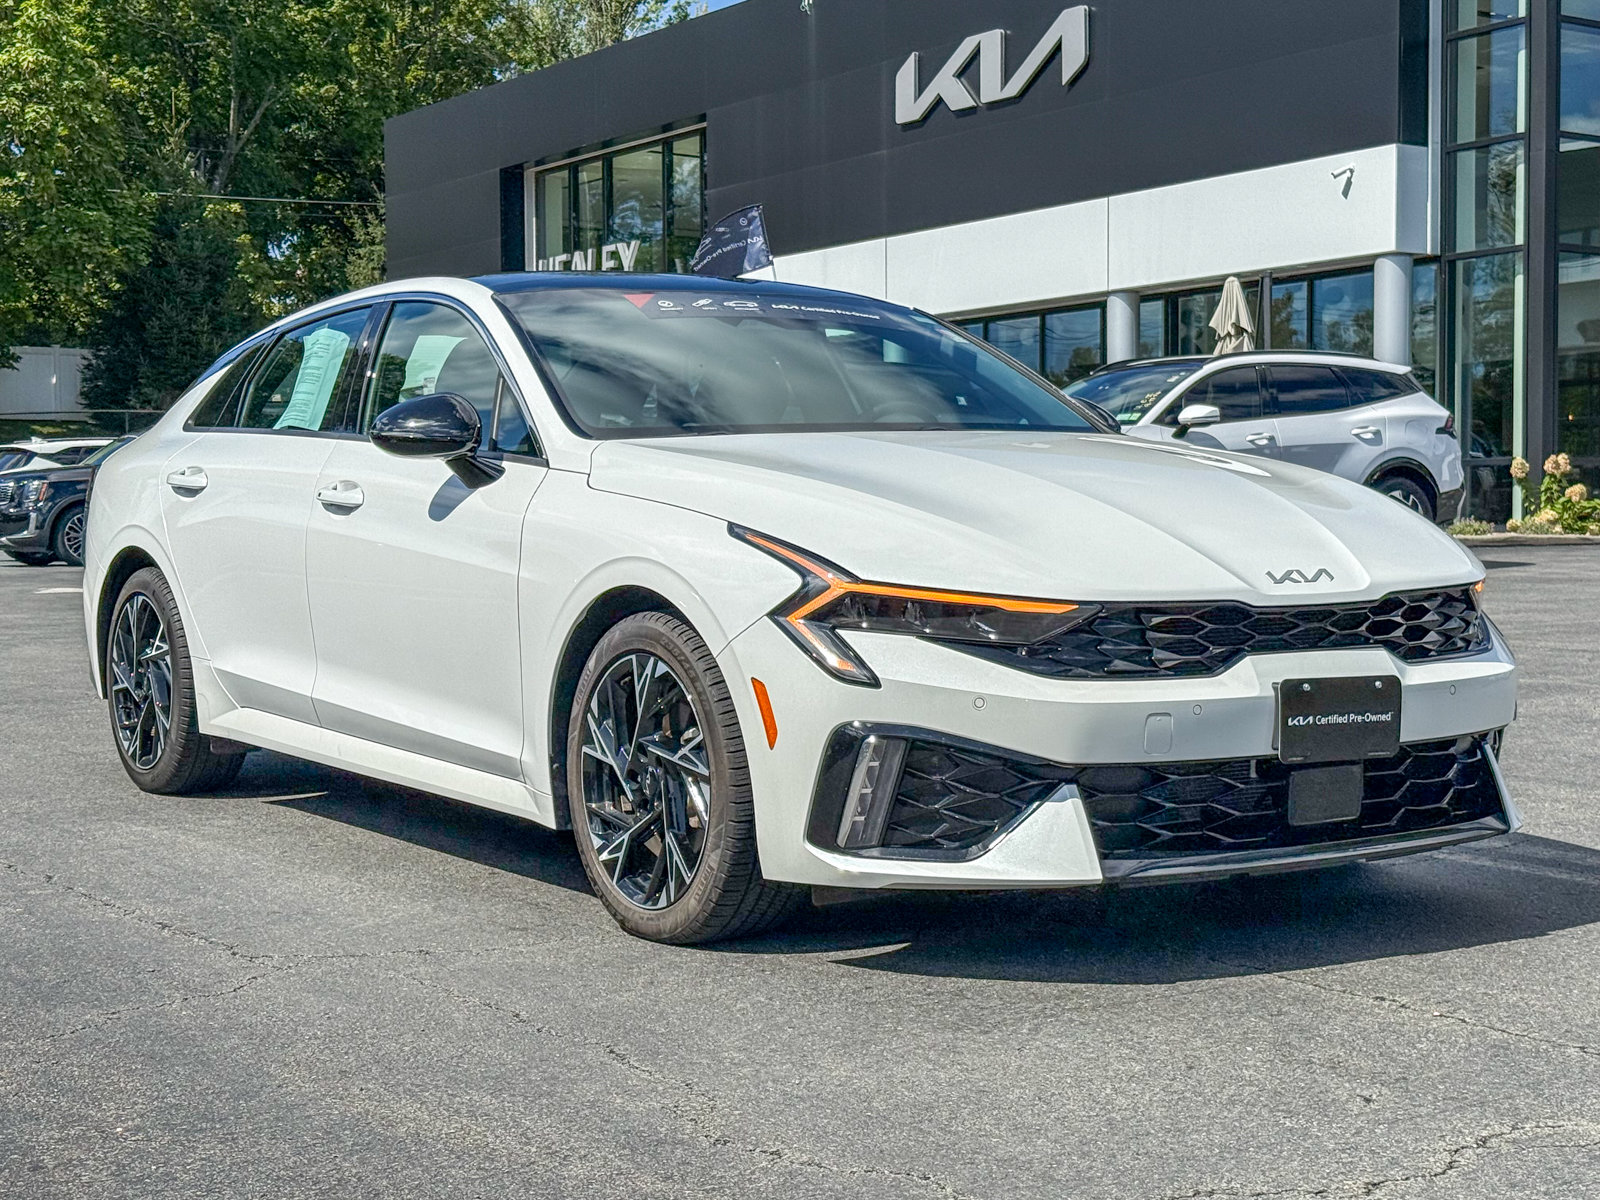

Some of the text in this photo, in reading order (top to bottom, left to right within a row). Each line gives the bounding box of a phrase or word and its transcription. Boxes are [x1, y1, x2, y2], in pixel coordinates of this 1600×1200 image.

[895, 5, 1091, 126] KIA
[538, 240, 641, 271] ALEY
[1265, 567, 1335, 585] KIA
[1287, 711, 1392, 726] KIA Certified Pre-Owned
